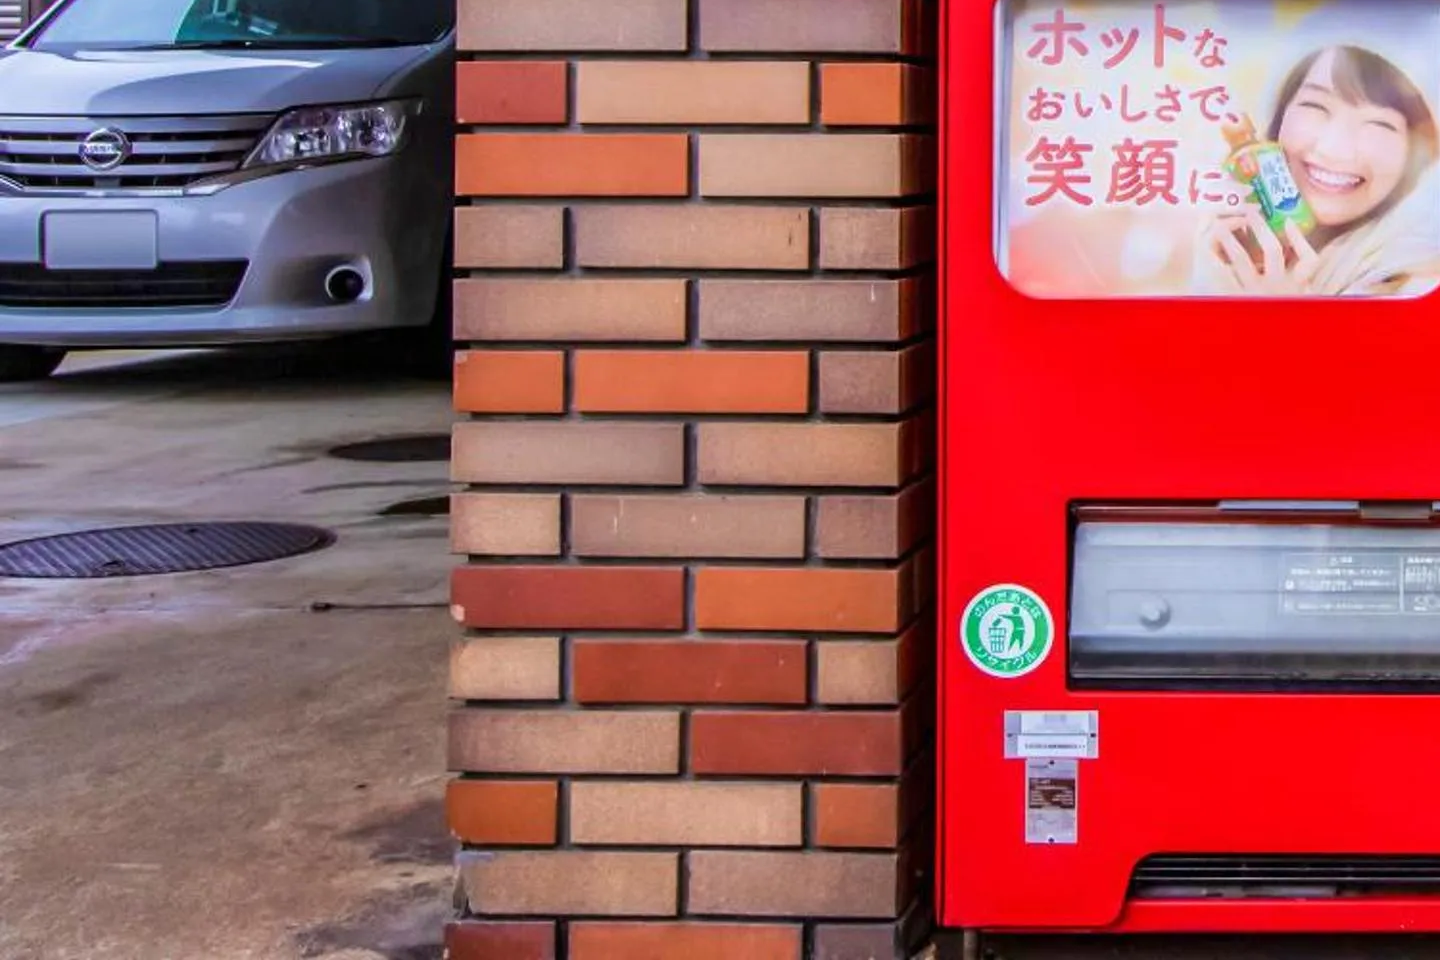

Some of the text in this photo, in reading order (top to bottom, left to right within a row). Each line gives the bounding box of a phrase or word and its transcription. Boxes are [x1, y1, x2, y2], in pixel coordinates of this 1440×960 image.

[1026, 3, 1228, 68] ホットな
[1026, 83, 1240, 123] おいしさで、
[1024, 136, 1241, 208] 笑顔に。
[976, 646, 1037, 671] リサイクル
